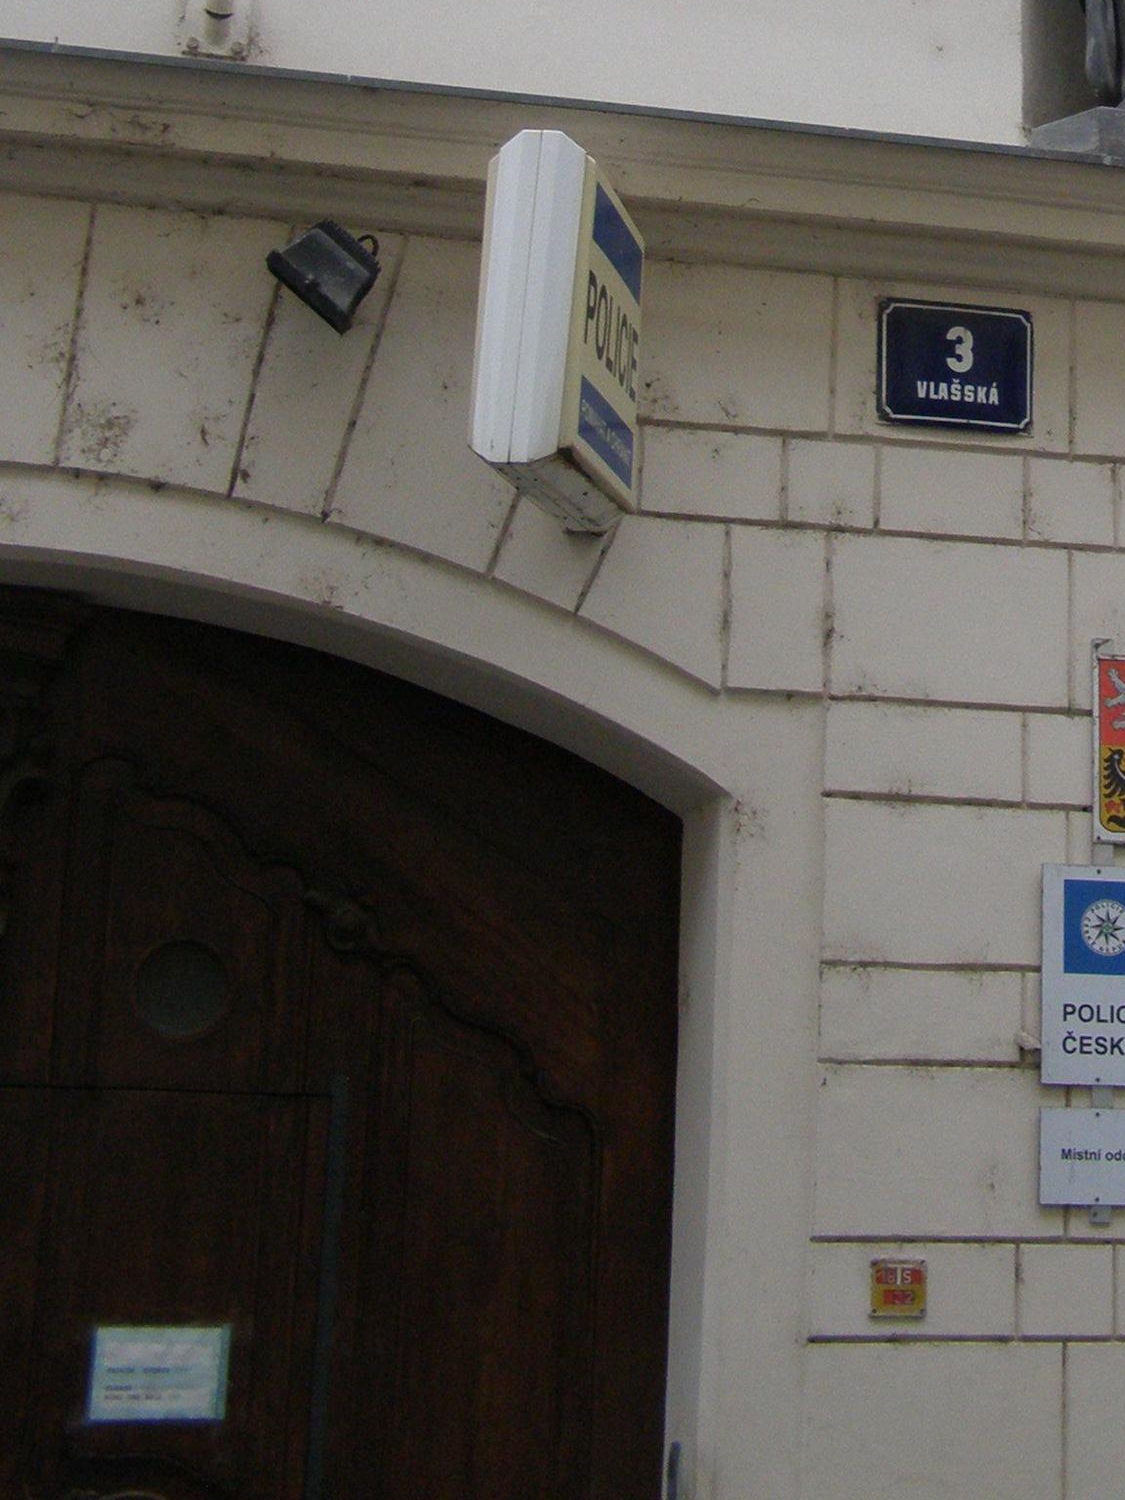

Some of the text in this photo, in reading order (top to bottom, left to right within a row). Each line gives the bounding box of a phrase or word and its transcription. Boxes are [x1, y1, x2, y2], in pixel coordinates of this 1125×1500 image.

[584, 269, 639, 403] POLICIE
[946, 326, 974, 373] 3
[917, 378, 999, 405] VLAŠSKÁ
[1061, 1148, 1101, 1161] Místní
